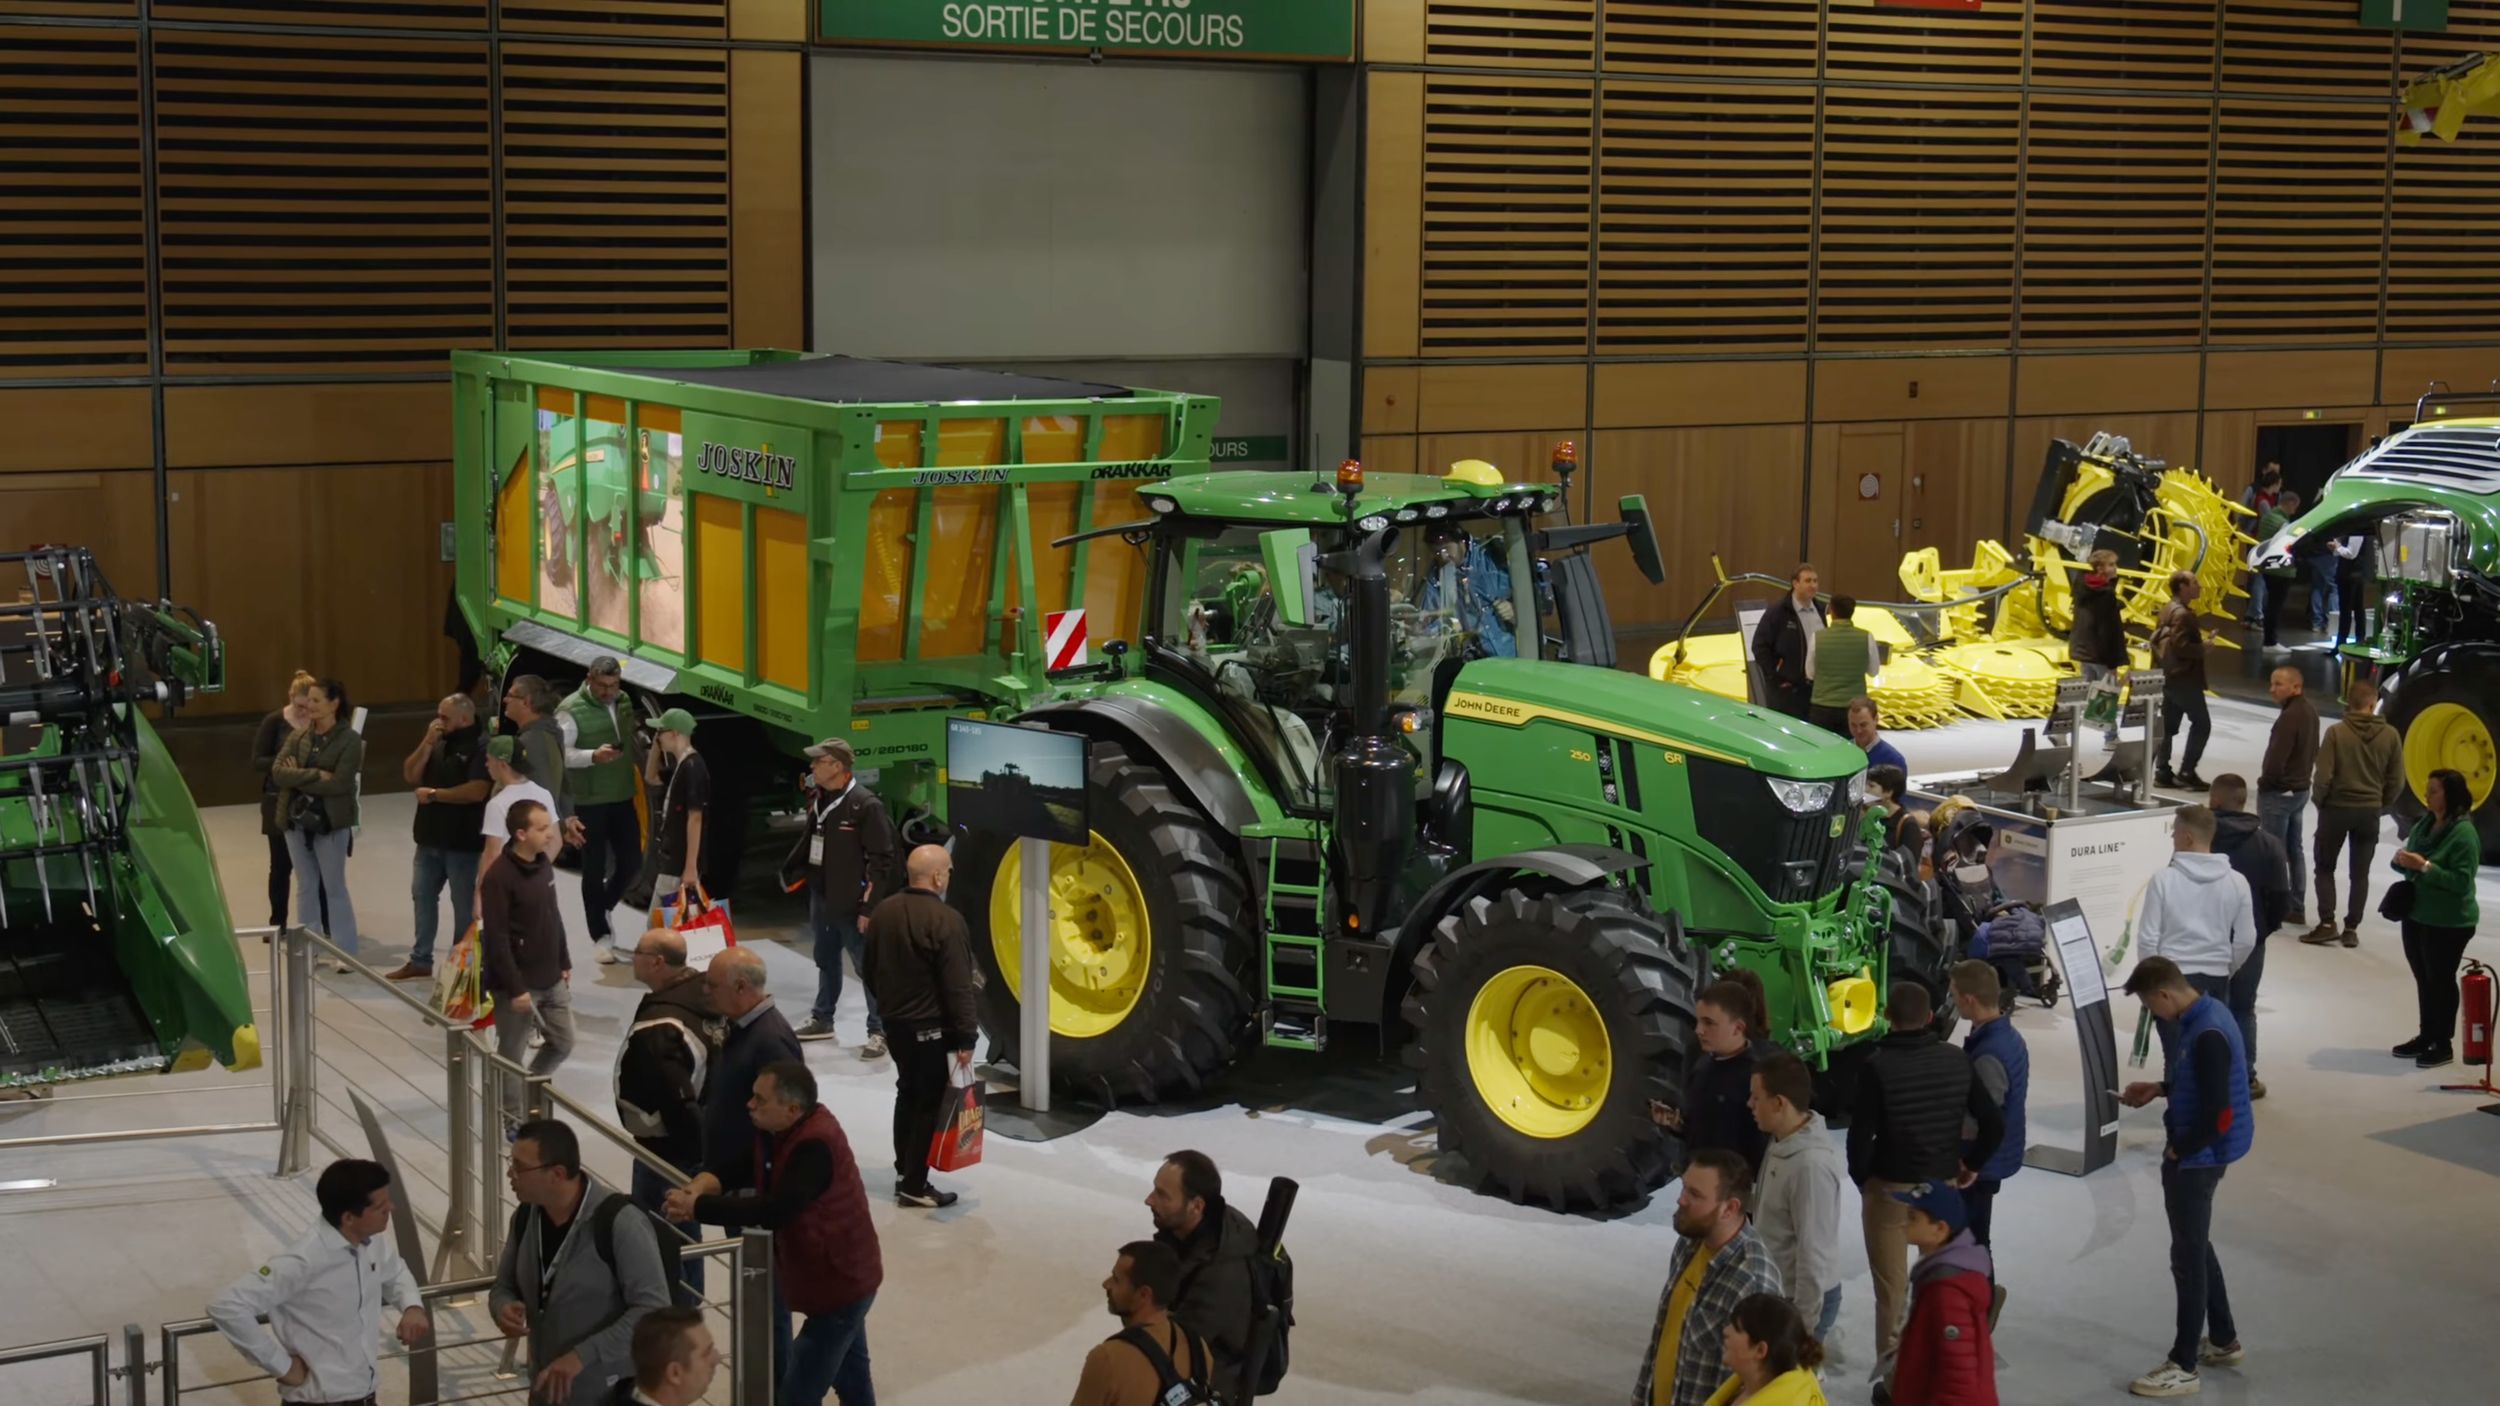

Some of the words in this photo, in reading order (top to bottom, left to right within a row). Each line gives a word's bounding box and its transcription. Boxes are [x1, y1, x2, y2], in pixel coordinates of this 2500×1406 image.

[942, 4, 1049, 40] SORTIE
[1059, 8, 1097, 41] DE
[1105, 10, 1244, 47] SECOURS
[697, 441, 796, 491] JOSKIN
[1090, 462, 1172, 479] DRAKKAR
[912, 468, 1010, 486] JOSKIN
[700, 684, 735, 706] DRAKKAR
[1454, 697, 1482, 710] JOHN
[1484, 701, 1520, 717] DEERE
[1569, 749, 1591, 762] 250
[1663, 751, 1684, 765] 6R
[2070, 846, 2096, 857] DURA
